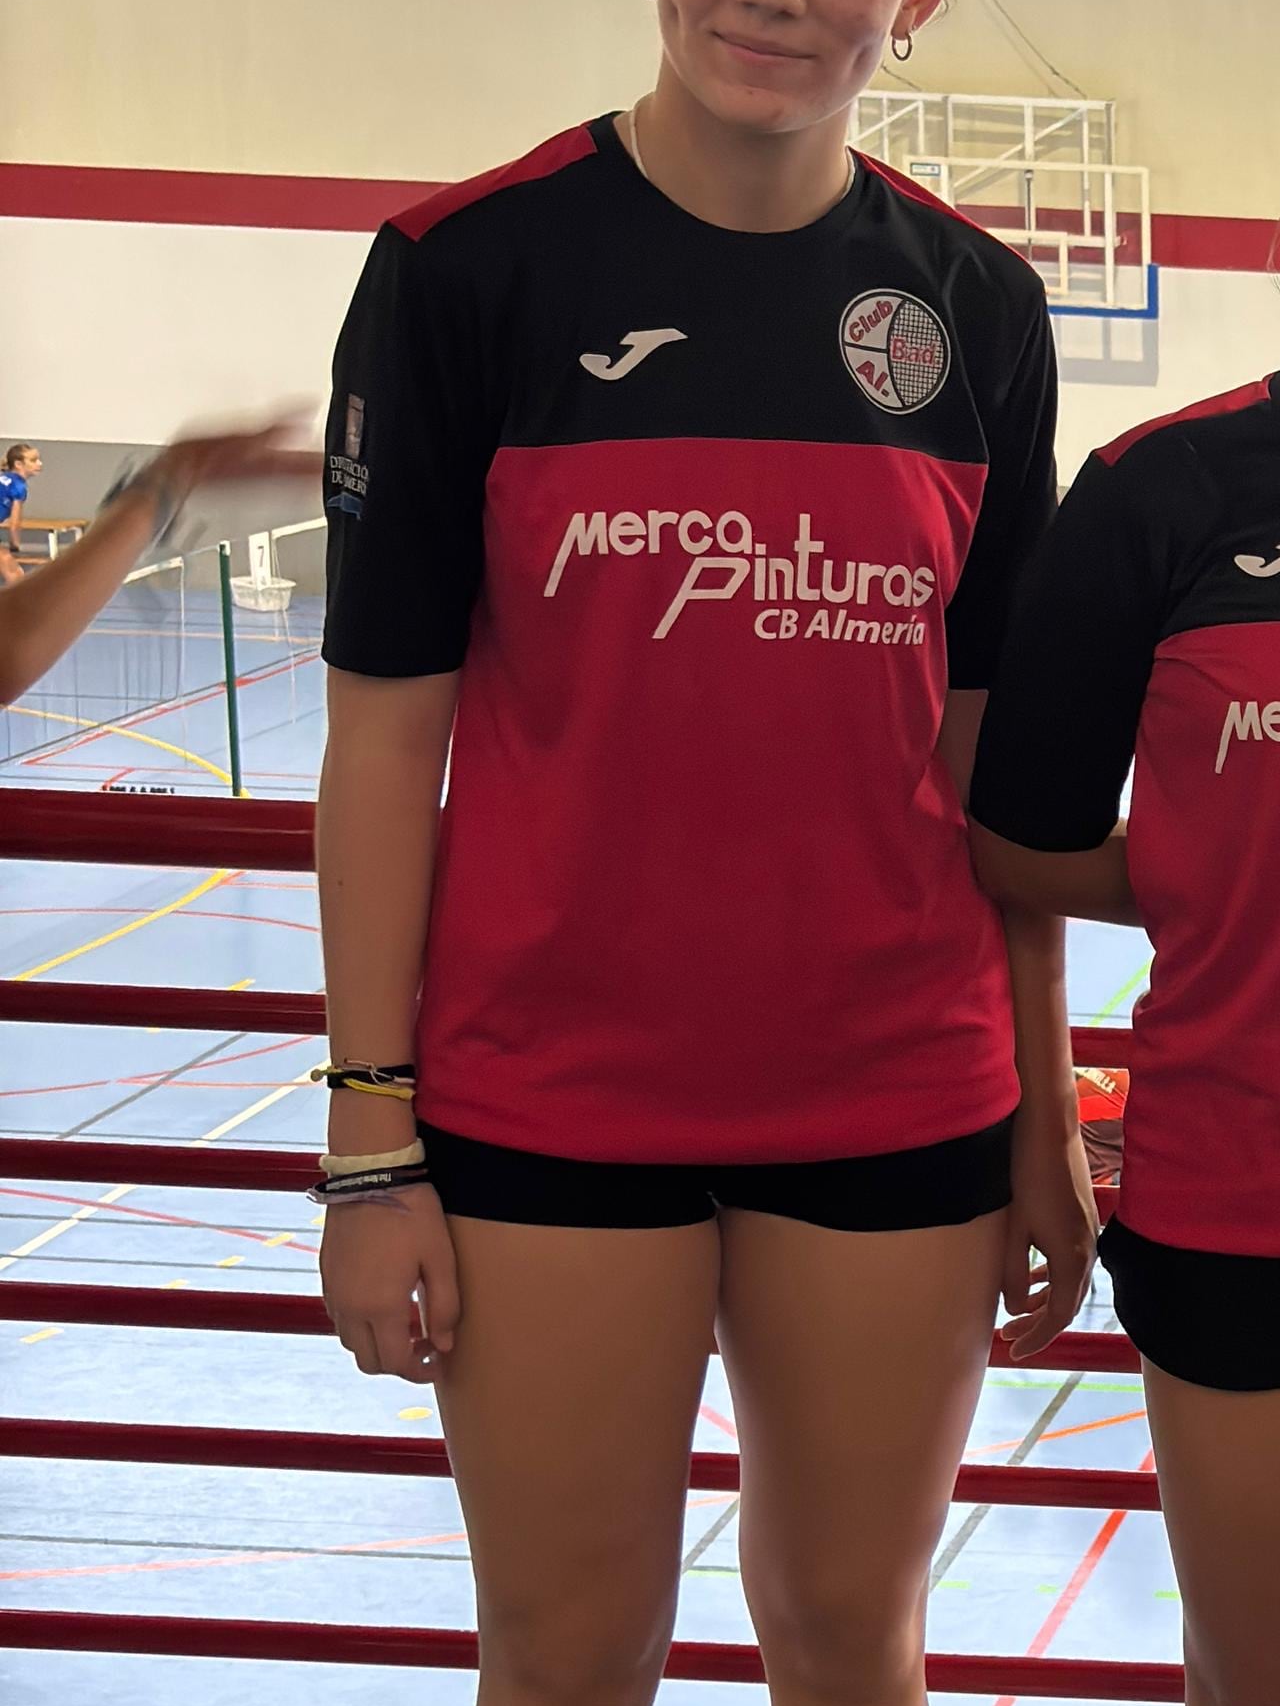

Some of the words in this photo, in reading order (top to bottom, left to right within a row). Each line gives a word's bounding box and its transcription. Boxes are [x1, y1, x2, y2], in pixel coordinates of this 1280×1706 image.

[849, 300, 894, 342] Club
[652, 513, 936, 640] Pinturas
[753, 609, 798, 641] CB
[806, 609, 926, 646] Almería
